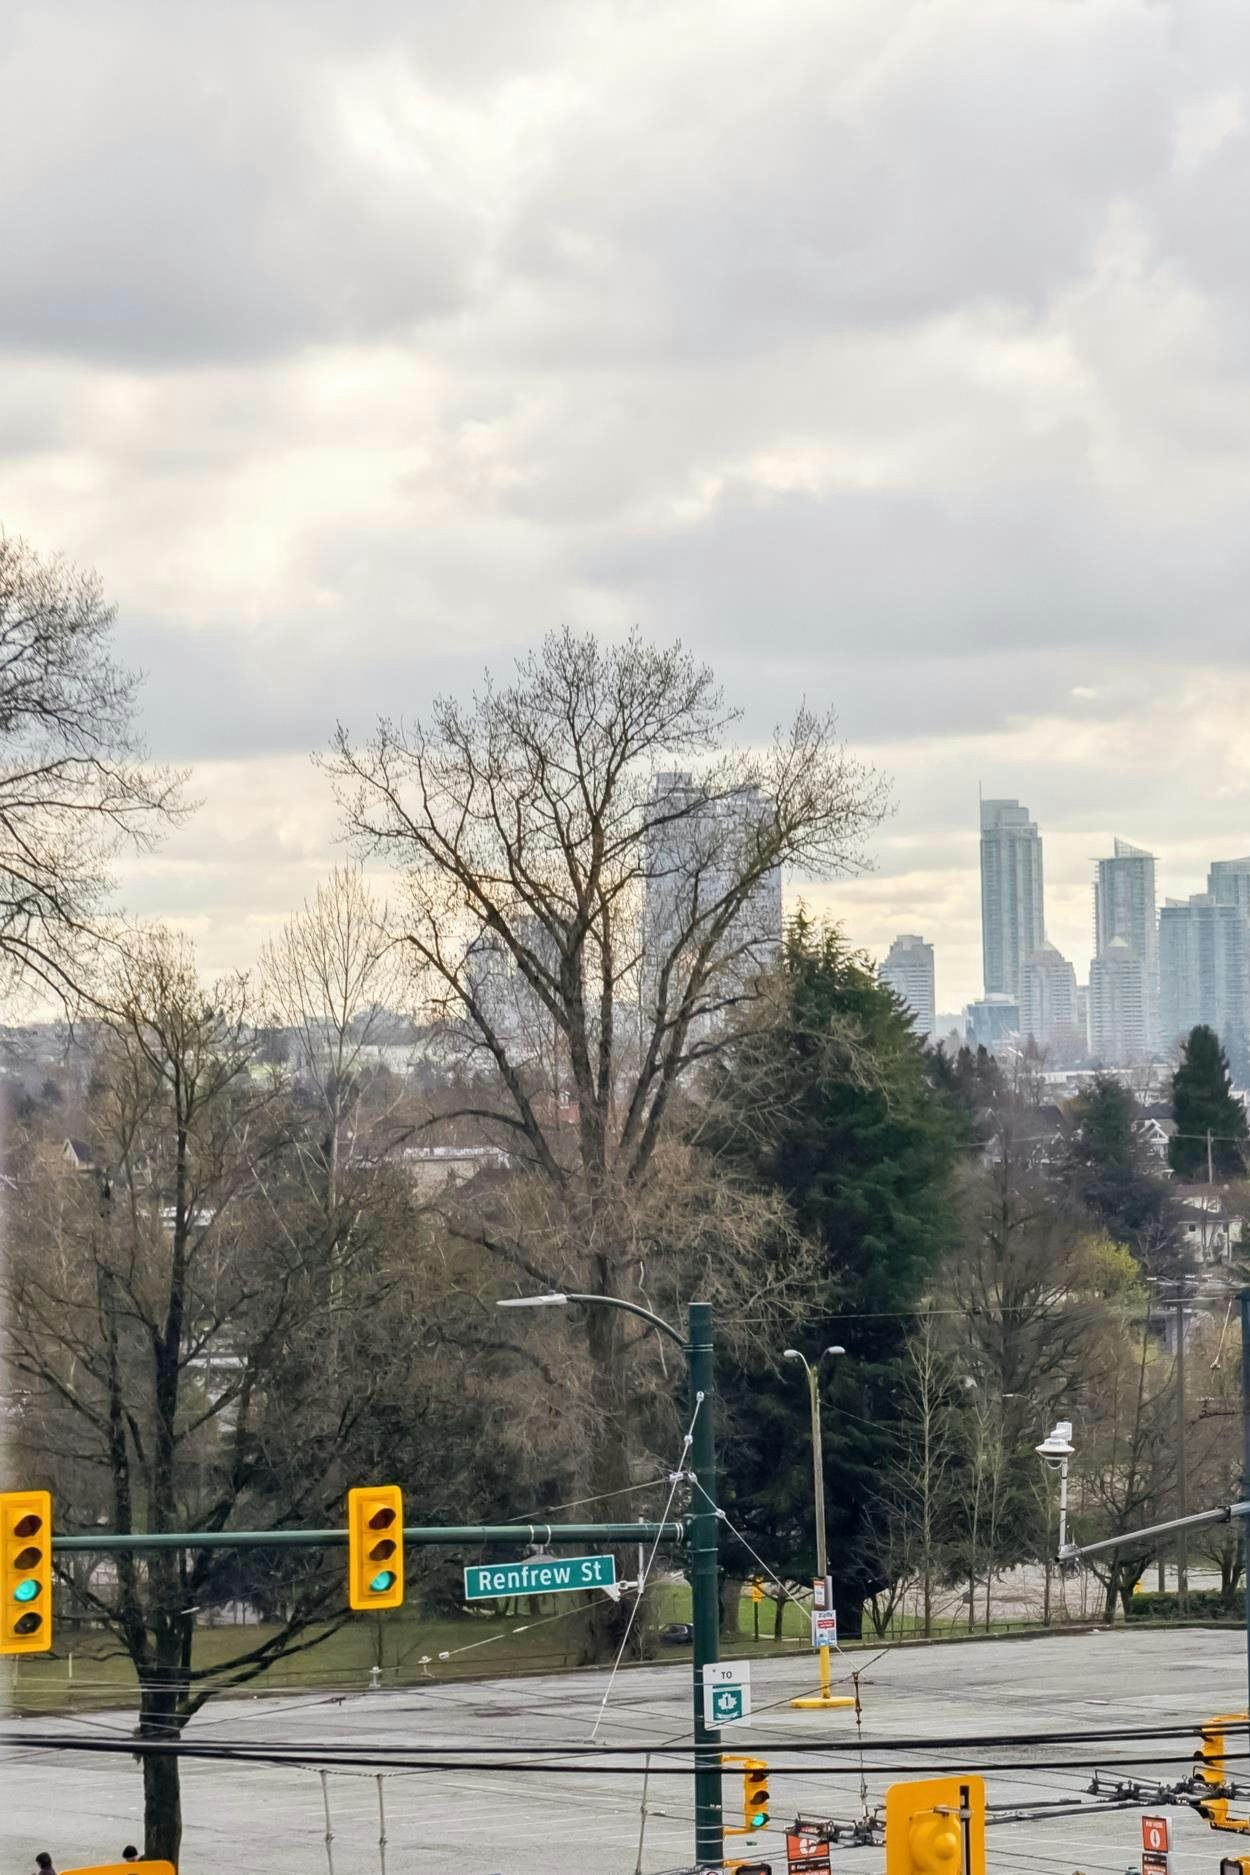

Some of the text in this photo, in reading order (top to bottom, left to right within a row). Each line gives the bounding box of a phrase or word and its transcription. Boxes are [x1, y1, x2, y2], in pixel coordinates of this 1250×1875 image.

[479, 1561, 602, 1591] Renfrew St
[721, 1671, 733, 1679] TO
